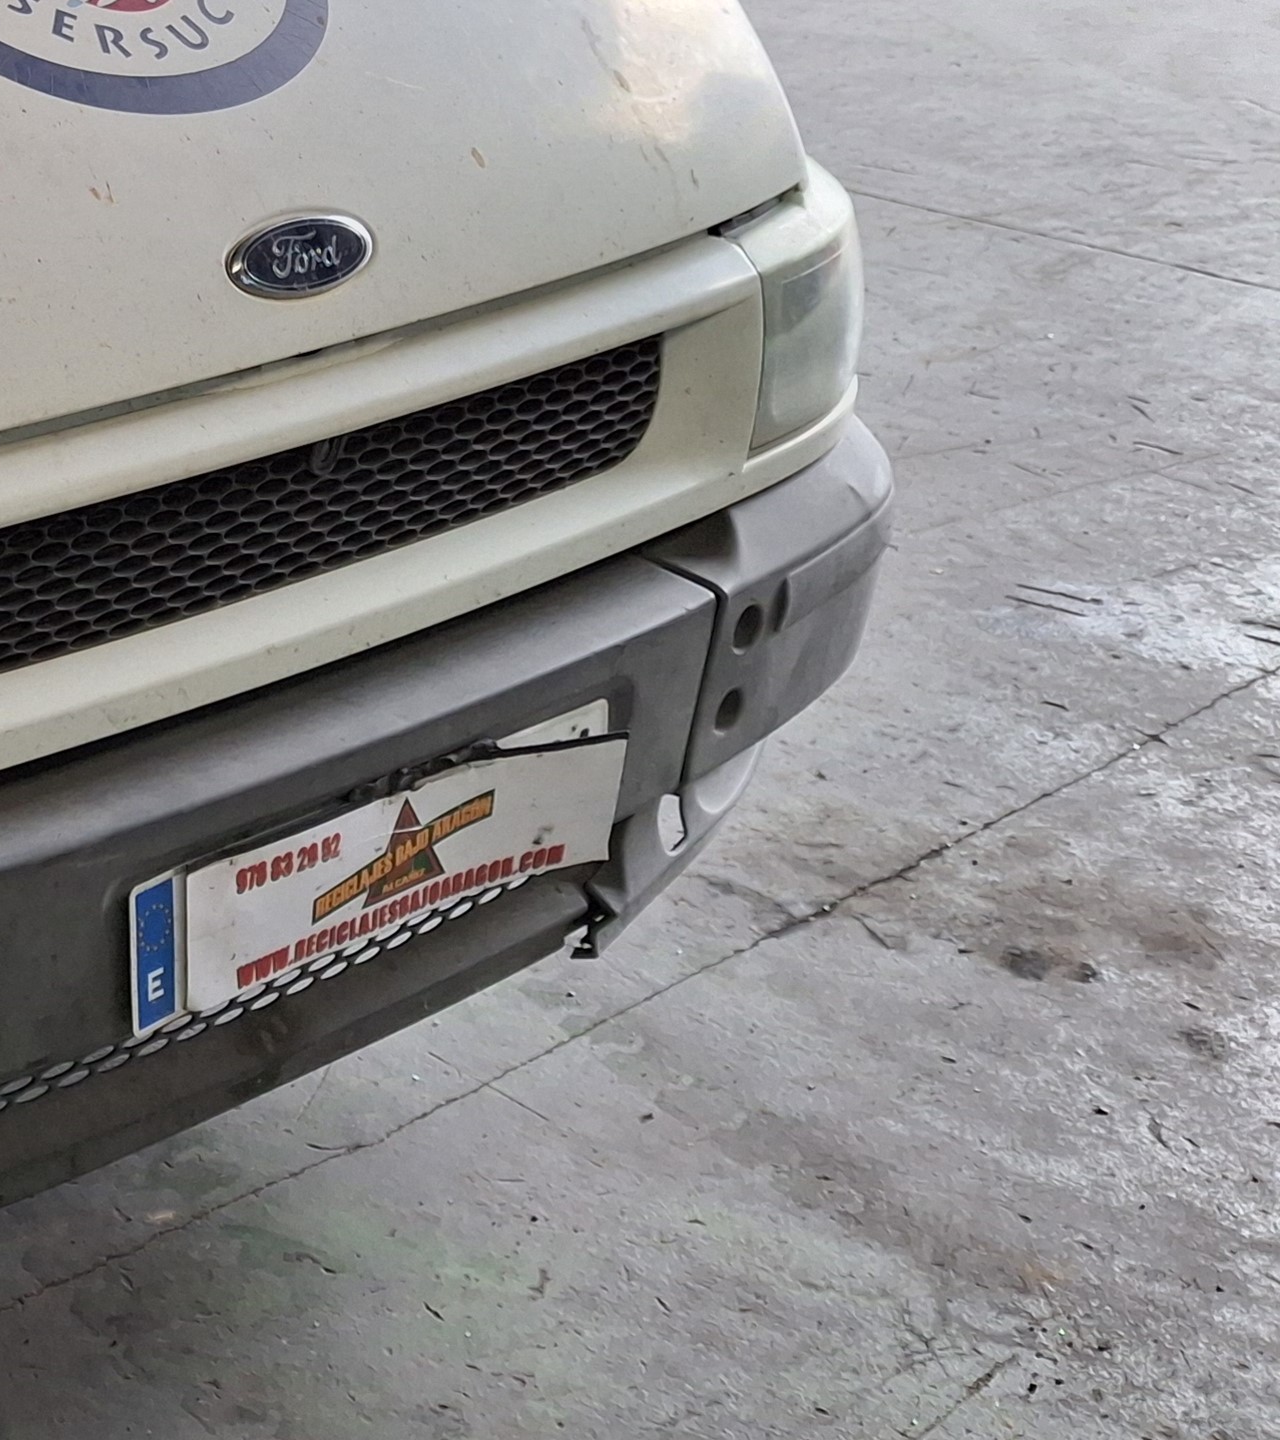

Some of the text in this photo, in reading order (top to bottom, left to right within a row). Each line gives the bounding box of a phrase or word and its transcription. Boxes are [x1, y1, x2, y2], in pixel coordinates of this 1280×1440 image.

[271, 229, 341, 279] Ford
[270, 851, 294, 882] 83
[316, 851, 393, 915] RECICLAJES
[396, 828, 430, 867] BAJO
[236, 843, 566, 991] WWW.RECICLAJESBAJOARAGON.COM
[147, 966, 165, 1002] E
